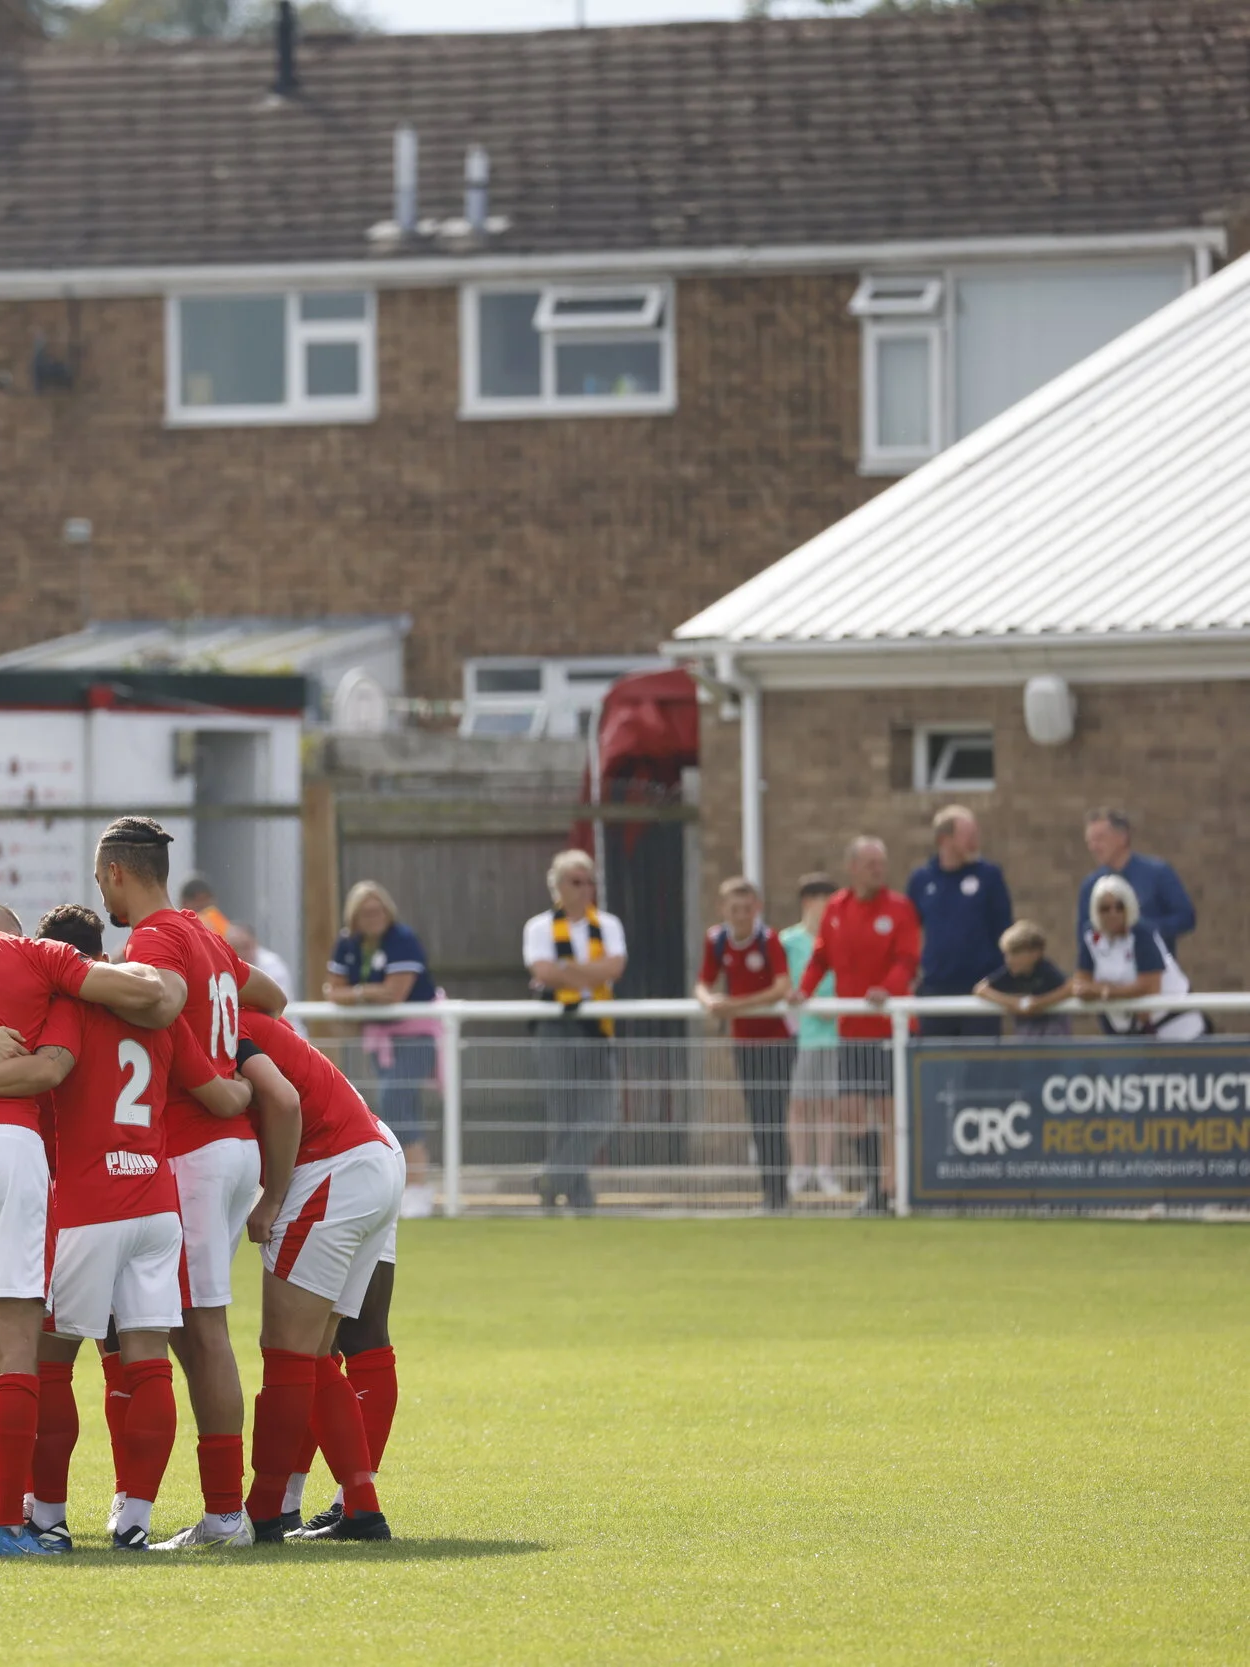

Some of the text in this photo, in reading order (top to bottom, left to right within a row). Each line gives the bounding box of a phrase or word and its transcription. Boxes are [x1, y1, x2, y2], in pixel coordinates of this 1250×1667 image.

[208, 971, 239, 1060] 10
[114, 1038, 152, 1127] 2
[953, 1101, 1033, 1155] CRC
[1043, 1117, 1250, 1153] RECRUITMEN
[105, 1150, 158, 1169] PUMA
[1099, 1158, 1205, 1178] RELATIONSHIPS
[1207, 1158, 1236, 1178] FOR
